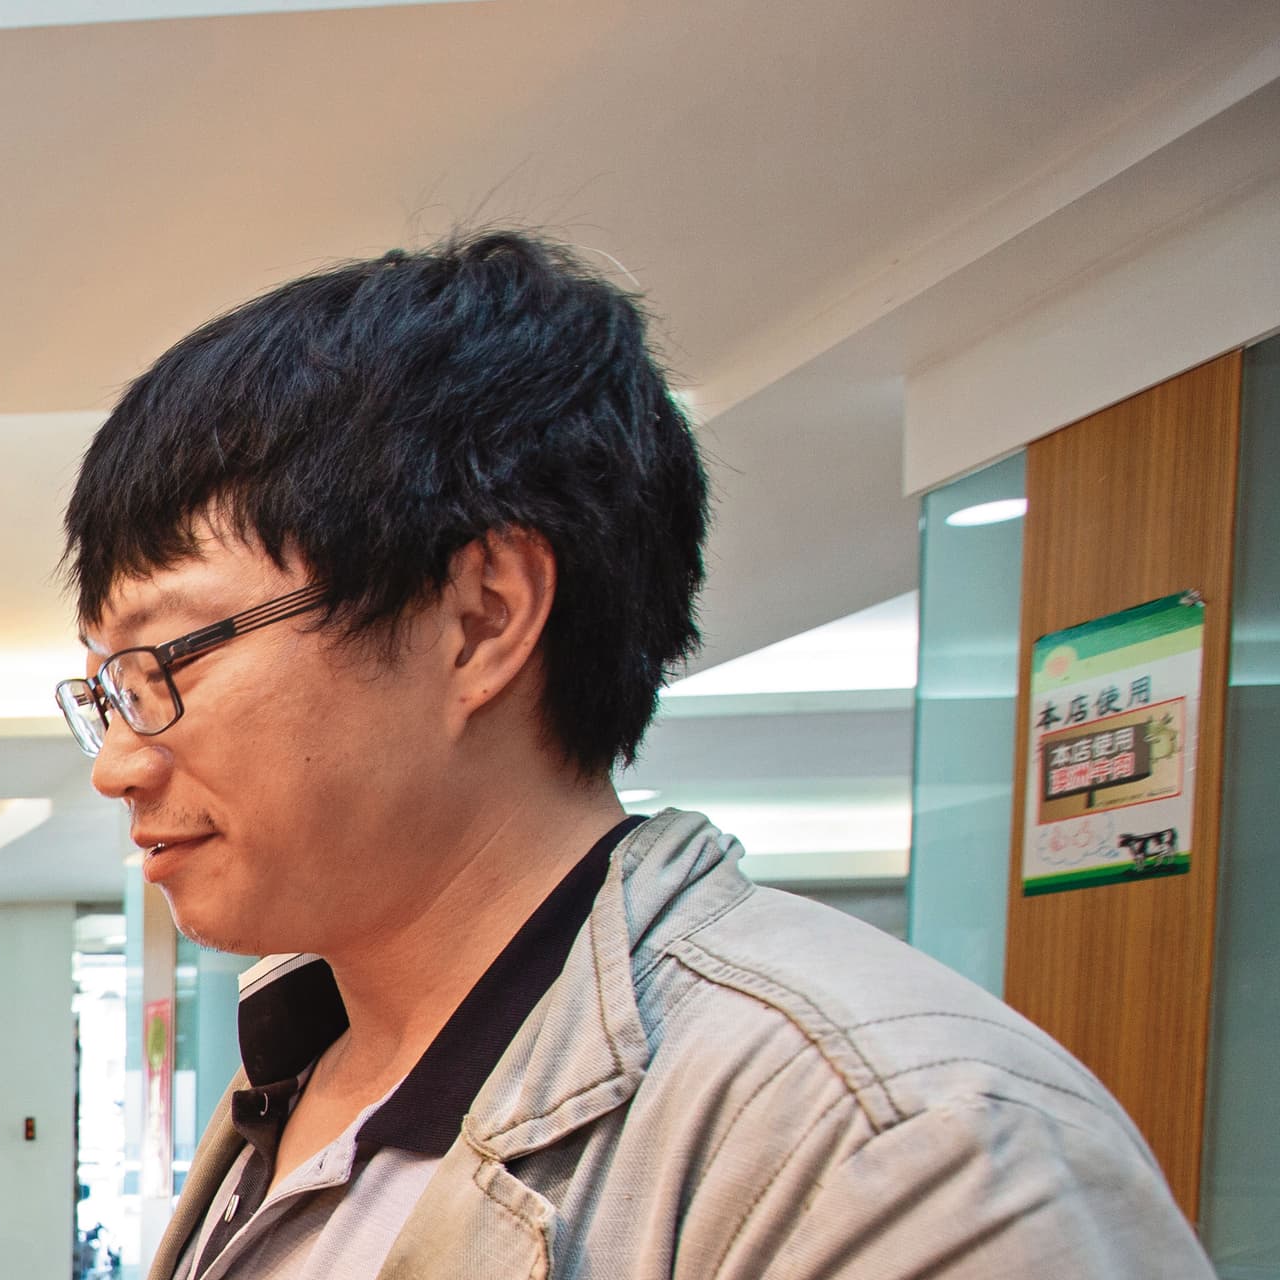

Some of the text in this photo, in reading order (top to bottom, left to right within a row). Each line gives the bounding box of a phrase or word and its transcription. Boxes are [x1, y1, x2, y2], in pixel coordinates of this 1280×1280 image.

[1036, 674, 1152, 729] 本店使用
[1049, 726, 1136, 769] 本店使用
